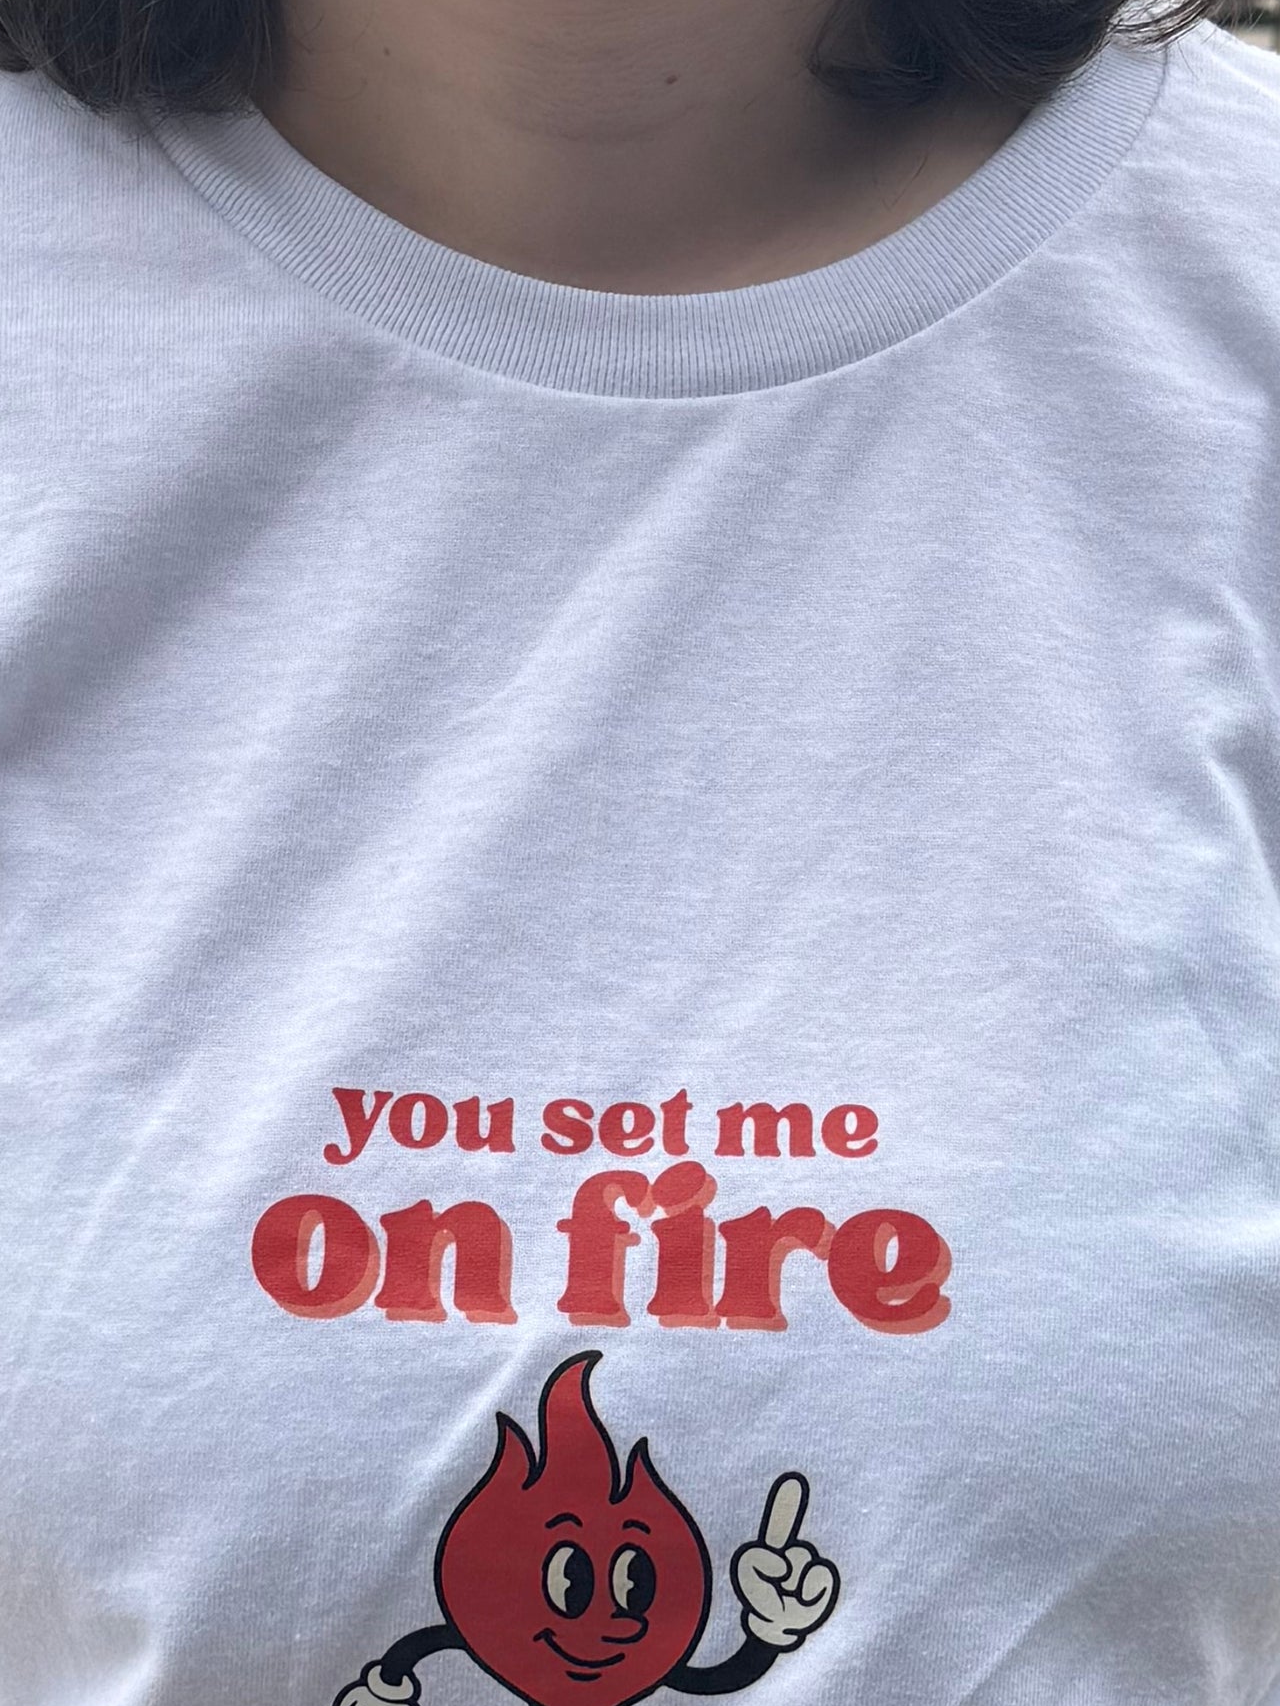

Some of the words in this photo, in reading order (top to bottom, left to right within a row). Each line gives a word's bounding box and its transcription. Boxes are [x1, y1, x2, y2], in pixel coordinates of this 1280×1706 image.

[322, 1087, 517, 1166] you
[540, 1088, 693, 1158] set
[714, 1102, 879, 1160] me
[250, 1193, 518, 1325] on
[555, 1159, 953, 1336] fire
